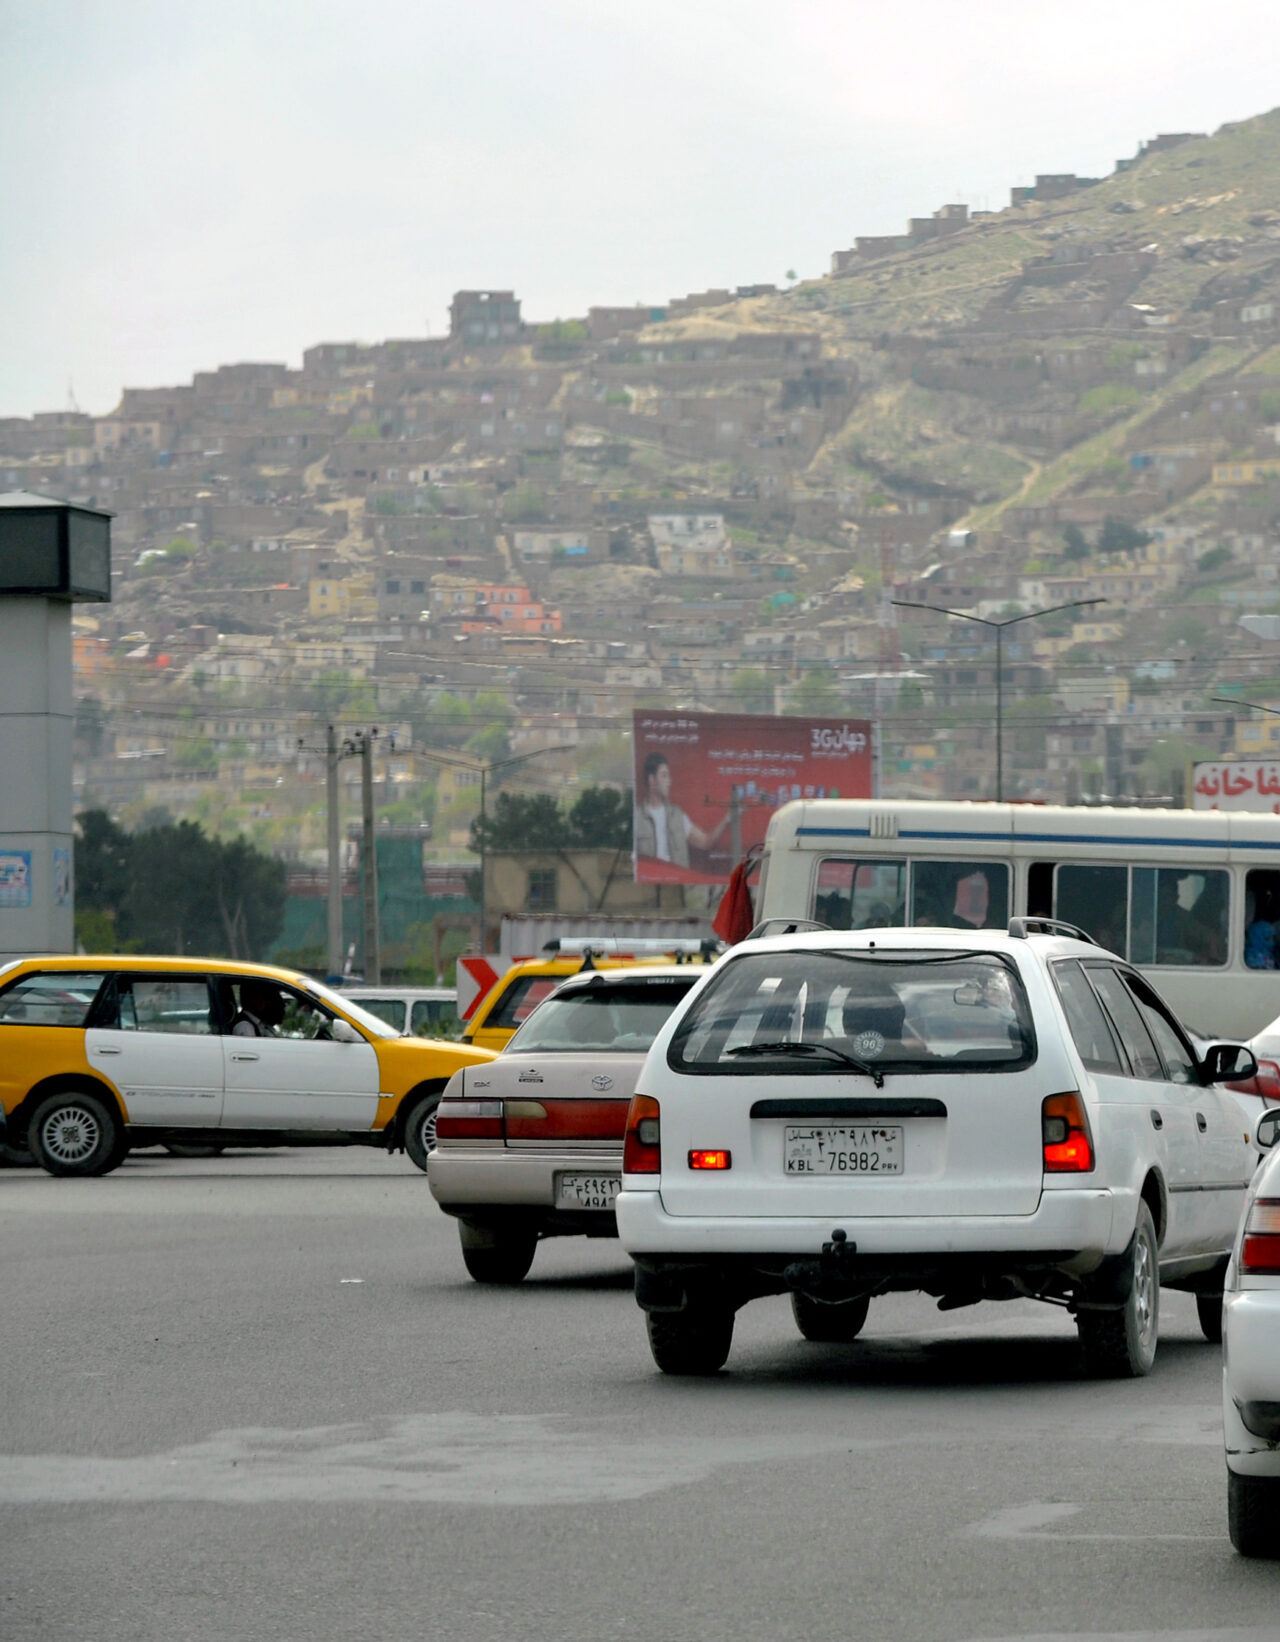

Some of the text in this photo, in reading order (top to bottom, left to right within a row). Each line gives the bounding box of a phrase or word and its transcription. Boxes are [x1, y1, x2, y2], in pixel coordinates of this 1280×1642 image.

[810, 728, 832, 750] 3G
[863, 1040, 876, 1049] 96
[788, 1159, 814, 1171] KBL
[827, 1151, 880, 1171] 76982
